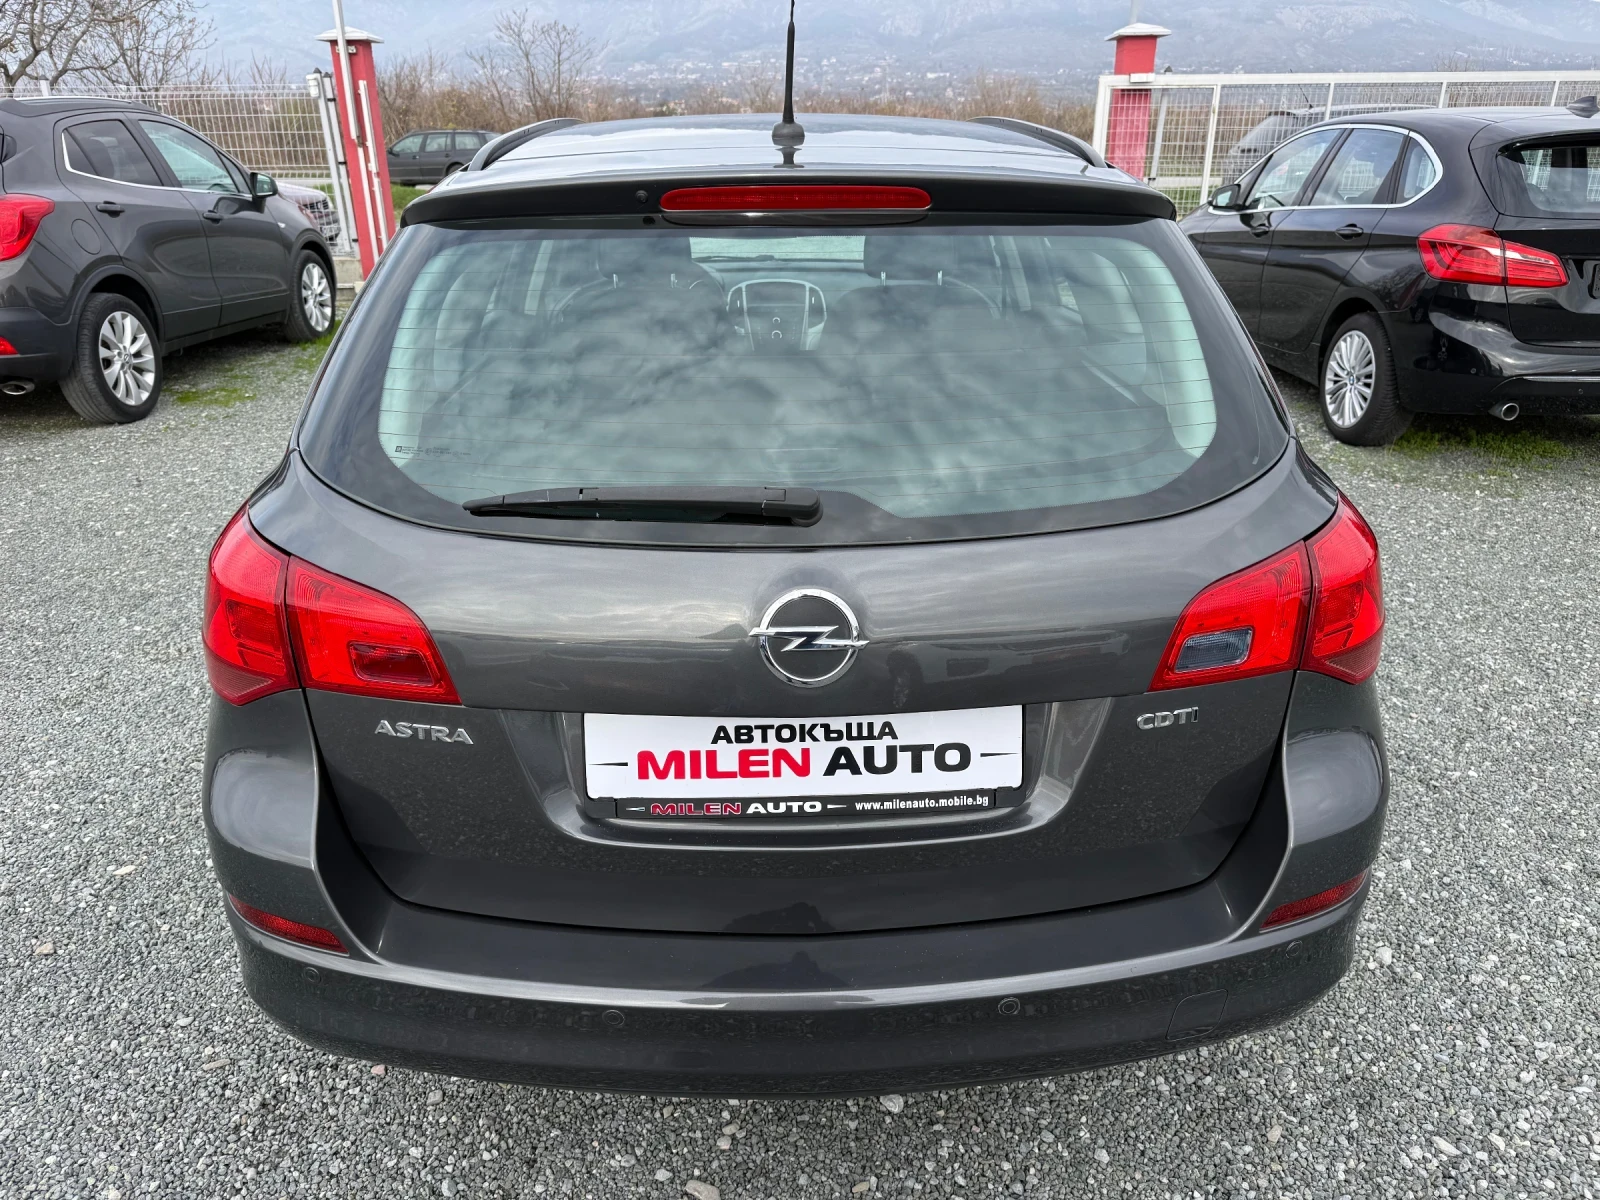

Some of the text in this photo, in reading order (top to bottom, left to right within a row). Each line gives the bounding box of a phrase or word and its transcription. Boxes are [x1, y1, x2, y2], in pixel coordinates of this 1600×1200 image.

[375, 719, 474, 745] ASTRA
[711, 721, 898, 744] АВТОКЪЩА
[637, 743, 972, 780] MILEN AUTO
[650, 795, 989, 815] MILEN AUTO www.milenauto.mobile.bg
